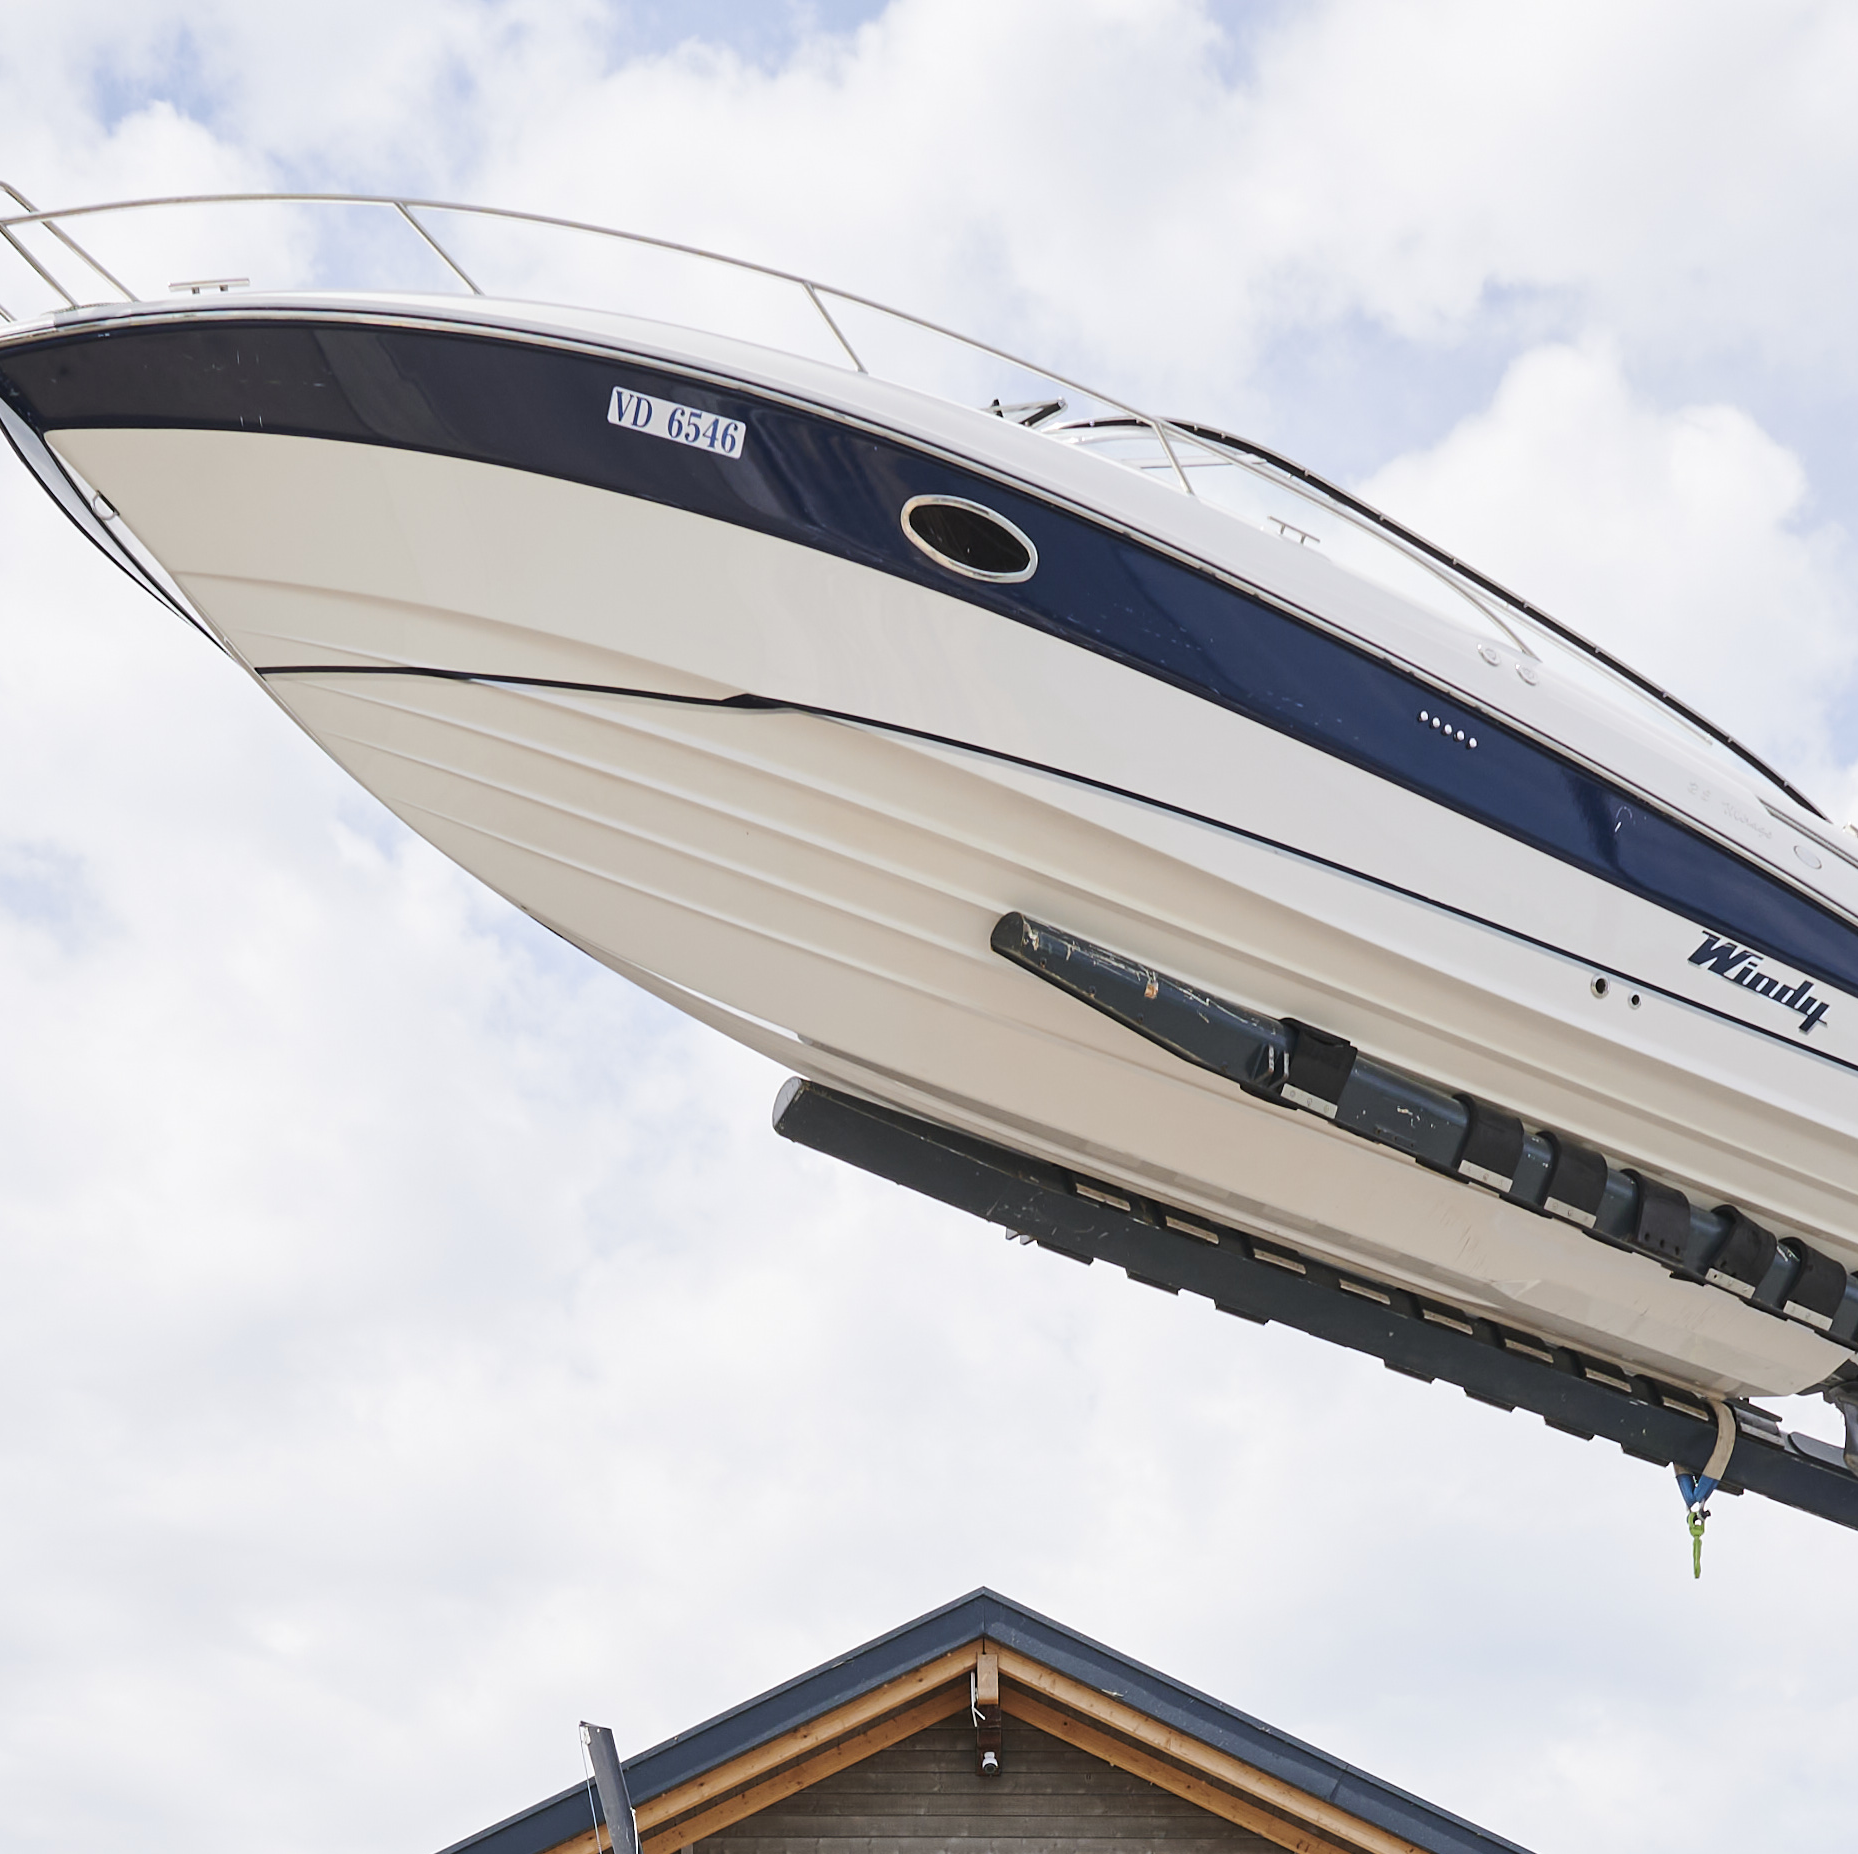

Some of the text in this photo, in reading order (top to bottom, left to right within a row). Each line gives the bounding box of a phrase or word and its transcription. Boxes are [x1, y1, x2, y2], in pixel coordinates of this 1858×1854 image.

[615, 390, 738, 453] VD 6546
[1687, 930, 1830, 1034] Windy
